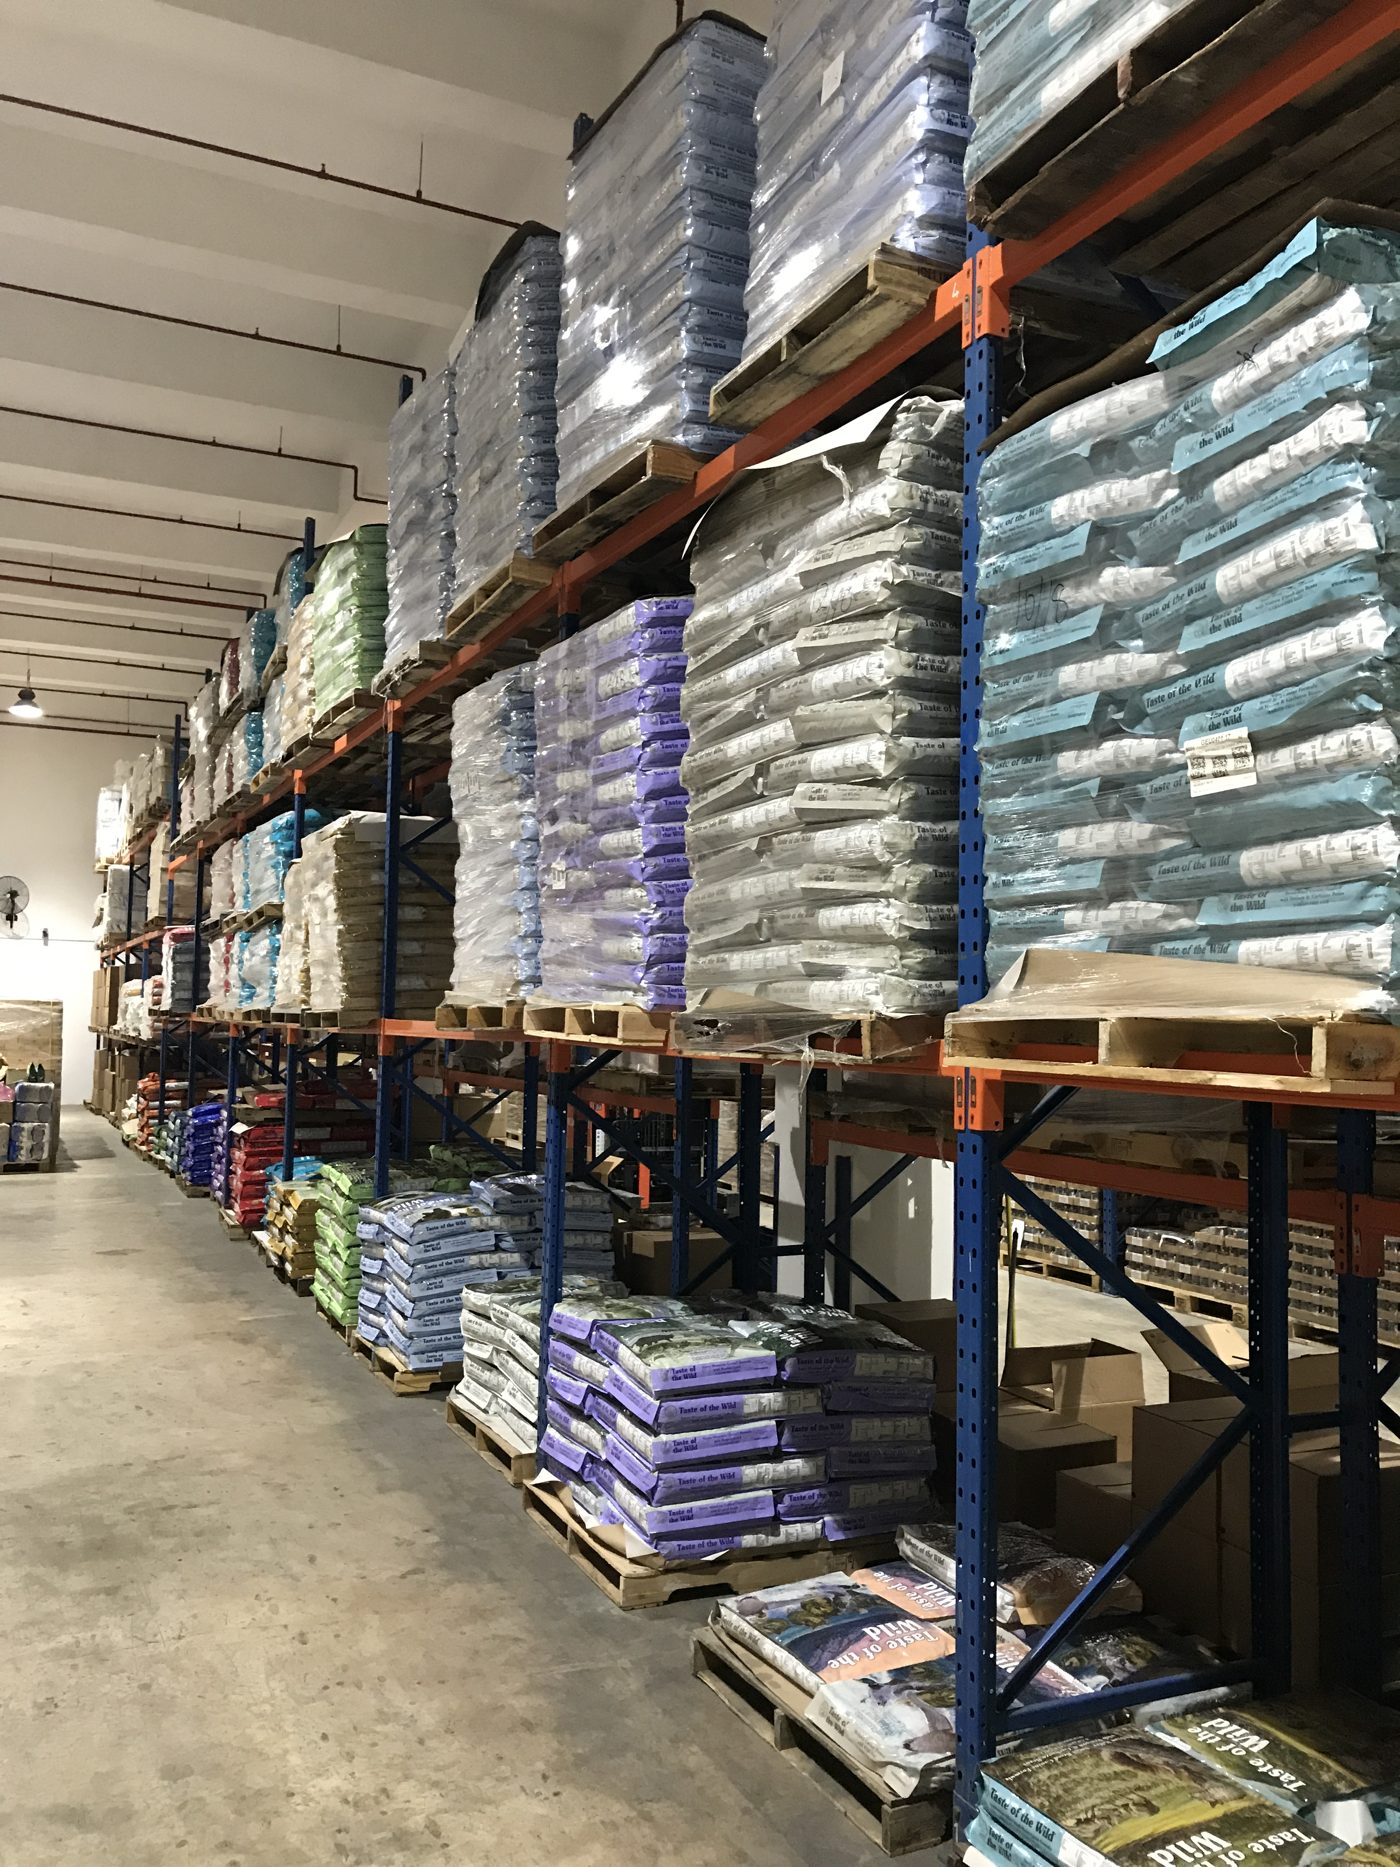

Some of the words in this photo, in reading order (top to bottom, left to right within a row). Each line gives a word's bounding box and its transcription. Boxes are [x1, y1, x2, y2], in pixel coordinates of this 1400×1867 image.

[1173, 328, 1186, 340] the
[1188, 314, 1206, 330] Wild
[1200, 436, 1213, 449] the
[1215, 424, 1234, 441] Wild
[1204, 531, 1217, 542] the
[1218, 518, 1238, 534] Wild
[911, 570, 931, 578] Taste
[1141, 606, 1160, 623] Taste
[1162, 598, 1170, 610] of
[1172, 592, 1184, 606] the
[1187, 580, 1206, 597] Wild
[925, 619, 946, 628] Taste
[1208, 622, 1222, 634] the
[1224, 612, 1242, 630] Wild
[916, 663, 928, 671] the
[930, 665, 948, 673] Wild
[662, 686, 680, 694] Taste
[1146, 694, 1165, 708] Taste
[1168, 688, 1176, 699] of
[1178, 682, 1191, 694] the
[1194, 672, 1216, 688] Wild
[920, 702, 942, 712] Taste
[944, 704, 952, 712] of
[1234, 703, 1244, 714] of
[1208, 720, 1221, 731] the
[1222, 713, 1242, 727] Wild
[661, 742, 678, 750] Taste
[938, 742, 946, 750] of
[1011, 758, 1021, 767] of
[926, 786, 948, 796] Taste
[1150, 782, 1169, 794] Taste
[1172, 778, 1182, 789] of
[917, 826, 936, 834] Taste
[1157, 864, 1180, 875] Taste
[1182, 860, 1192, 872] of
[1193, 859, 1206, 870] the
[1210, 854, 1232, 868] Wild
[934, 869, 955, 878] Taste
[924, 906, 945, 914] Taste
[946, 906, 954, 914] of
[1230, 902, 1244, 912] the
[1246, 900, 1266, 912] Wild
[938, 914, 956, 922] Wild
[1158, 945, 1180, 956] Taste
[1182, 944, 1192, 955] of
[1193, 944, 1206, 955] the
[1210, 942, 1230, 954] Wild
[426, 1224, 439, 1232] Taste
[672, 1367, 690, 1375] Taste
[672, 1374, 682, 1382] the
[682, 1372, 698, 1380] Wild
[679, 1406, 698, 1414] Taste
[699, 1404, 708, 1412] of
[708, 1404, 720, 1412] the
[720, 1402, 737, 1410] Wild
[809, 1424, 817, 1432] of
[672, 1446, 684, 1454] the
[684, 1444, 698, 1452] Wild
[678, 1477, 698, 1485] Taste
[698, 1476, 706, 1484] of
[708, 1474, 718, 1482] the
[720, 1472, 736, 1480] Wild
[788, 1494, 806, 1502] Taste
[808, 1493, 816, 1501] of
[668, 1516, 679, 1524] the
[680, 1514, 694, 1522] Wild
[676, 1543, 696, 1551] Taste
[697, 1540, 706, 1549] of
[707, 1539, 718, 1547] the
[719, 1537, 735, 1545] Wild
[934, 1554, 945, 1566] Wild
[873, 1570, 895, 1583] the
[887, 1582, 908, 1591] of
[914, 1581, 956, 1608] Wild
[861, 1618, 924, 1638] Wild
[886, 1629, 940, 1650] Taste
[862, 1644, 882, 1660] of
[827, 1650, 860, 1670] the
[828, 1706, 842, 1722] Taste
[1187, 1726, 1222, 1744] the
[1200, 1718, 1270, 1752] Wild
[1216, 1743, 1246, 1756] of
[1249, 1758, 1307, 1792] Taste
[990, 1788, 1009, 1810] Taste
[1010, 1807, 1022, 1818] of
[1020, 1814, 1034, 1828] the
[1035, 1821, 1056, 1842] Wild
[986, 1838, 997, 1850] the
[989, 1827, 1004, 1844] Taste
[1005, 1840, 1013, 1850] of
[1248, 1828, 1316, 1853] Taste
[1147, 1831, 1232, 1867] Wild
[1218, 1850, 1246, 1867] of
